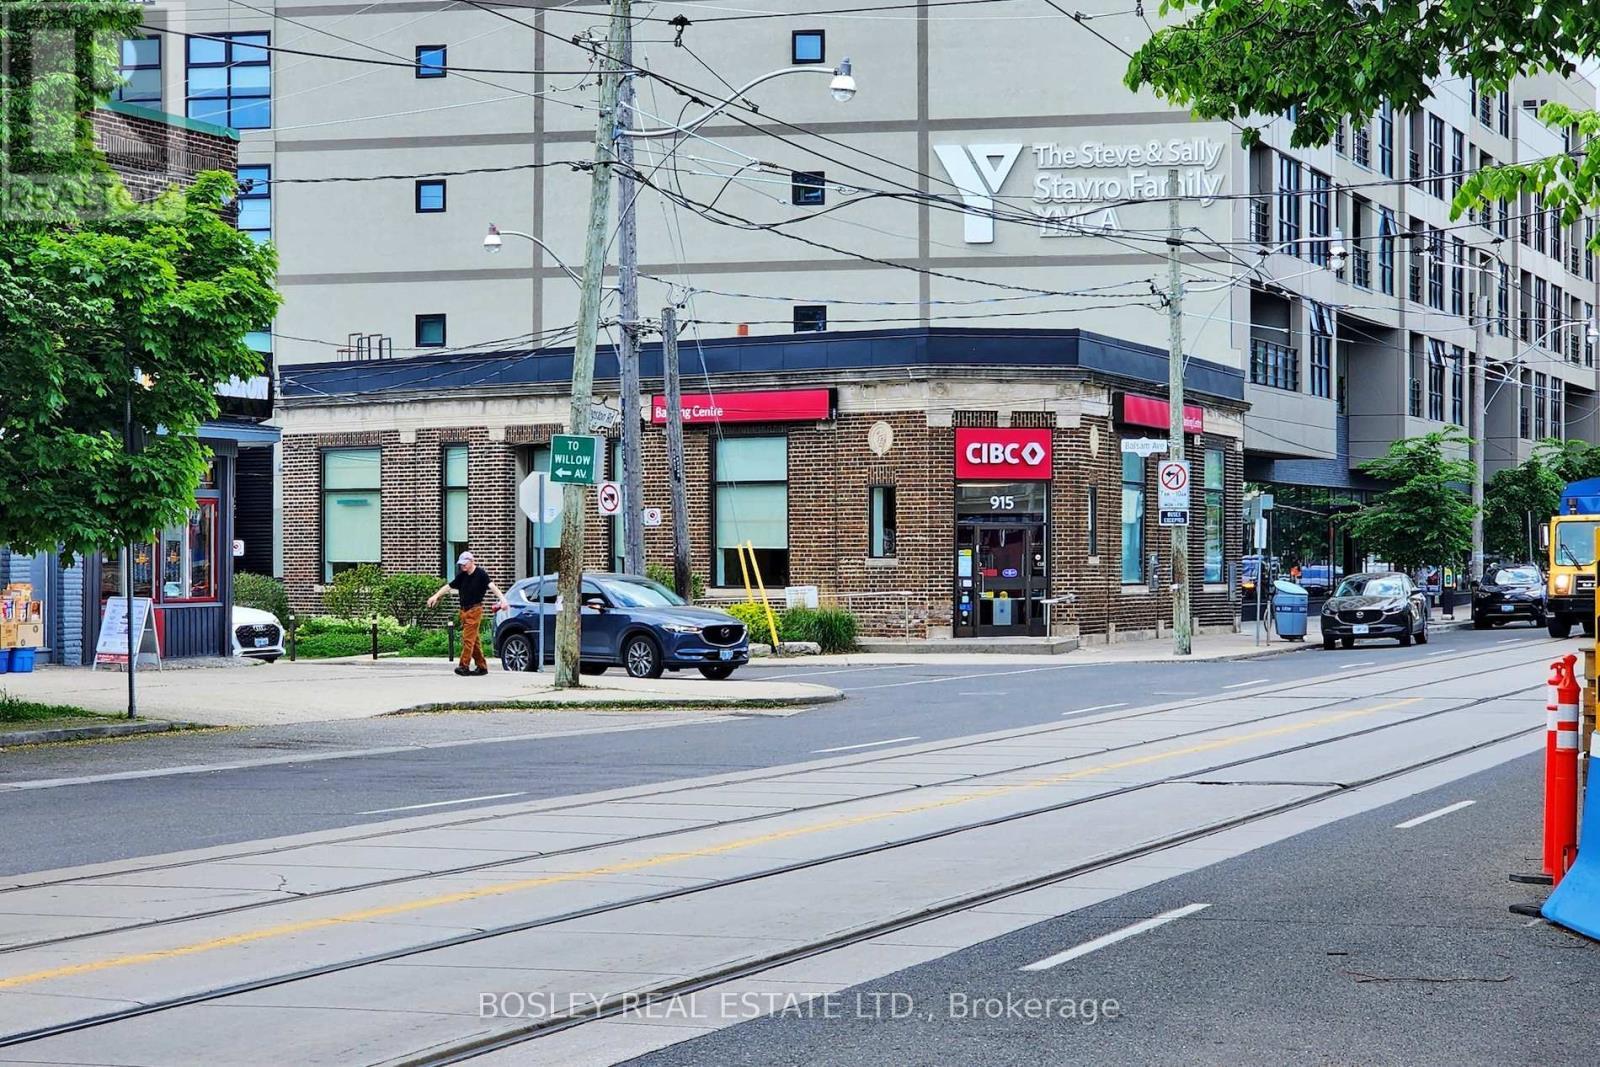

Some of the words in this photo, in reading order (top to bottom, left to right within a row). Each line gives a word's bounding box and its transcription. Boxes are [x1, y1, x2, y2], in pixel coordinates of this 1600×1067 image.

[1036, 145, 1075, 166] The
[1086, 143, 1141, 166] Steve
[1146, 143, 1162, 162] &
[1165, 140, 1224, 169] Sally
[1035, 174, 1121, 201] Stavro
[655, 407, 691, 419] Bang
[692, 405, 723, 417] Centre
[567, 440, 579, 451] TO
[1125, 441, 1150, 450] Balsam
[554, 454, 591, 465] WILLOW
[965, 442, 1020, 464] CIBC
[990, 496, 1014, 509] 915
